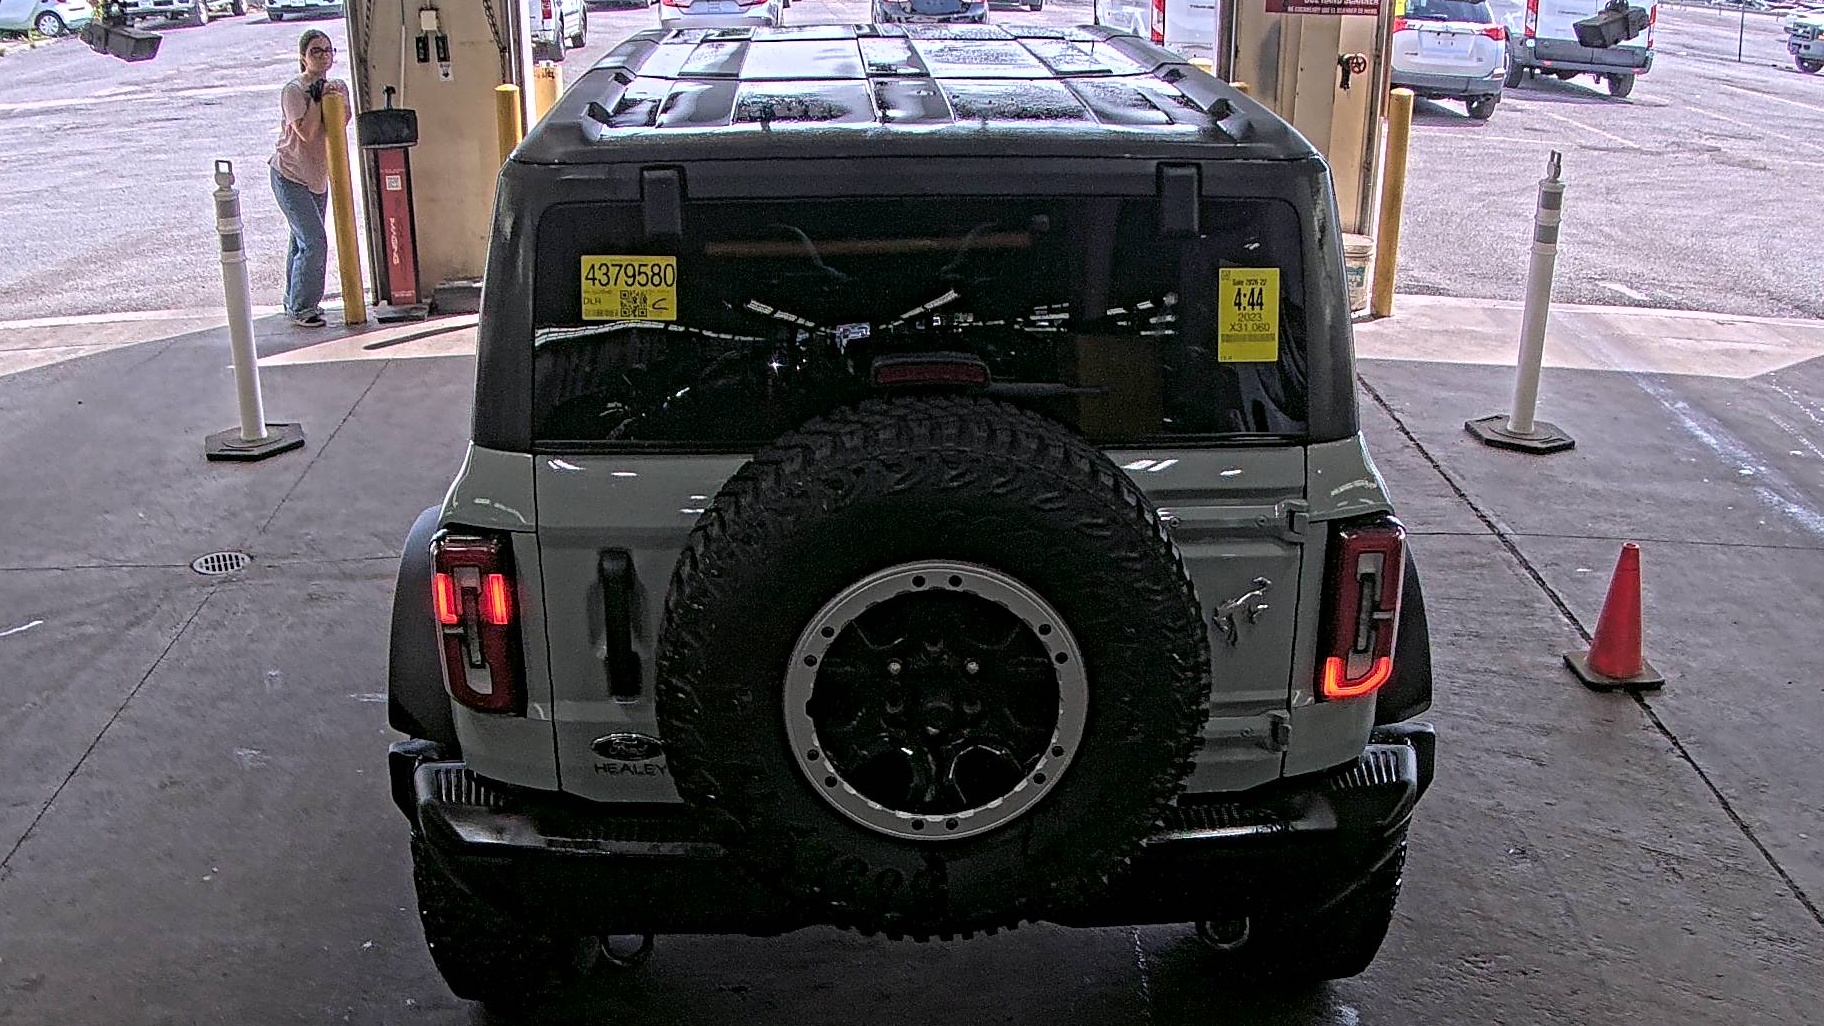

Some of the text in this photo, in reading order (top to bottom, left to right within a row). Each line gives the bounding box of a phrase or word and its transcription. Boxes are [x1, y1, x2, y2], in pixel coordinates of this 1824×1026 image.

[585, 263, 675, 287] 4379580
[1234, 287, 1264, 311] 4:44
[1237, 313, 1263, 322] 2023
[594, 762, 667, 777] HEALEY
